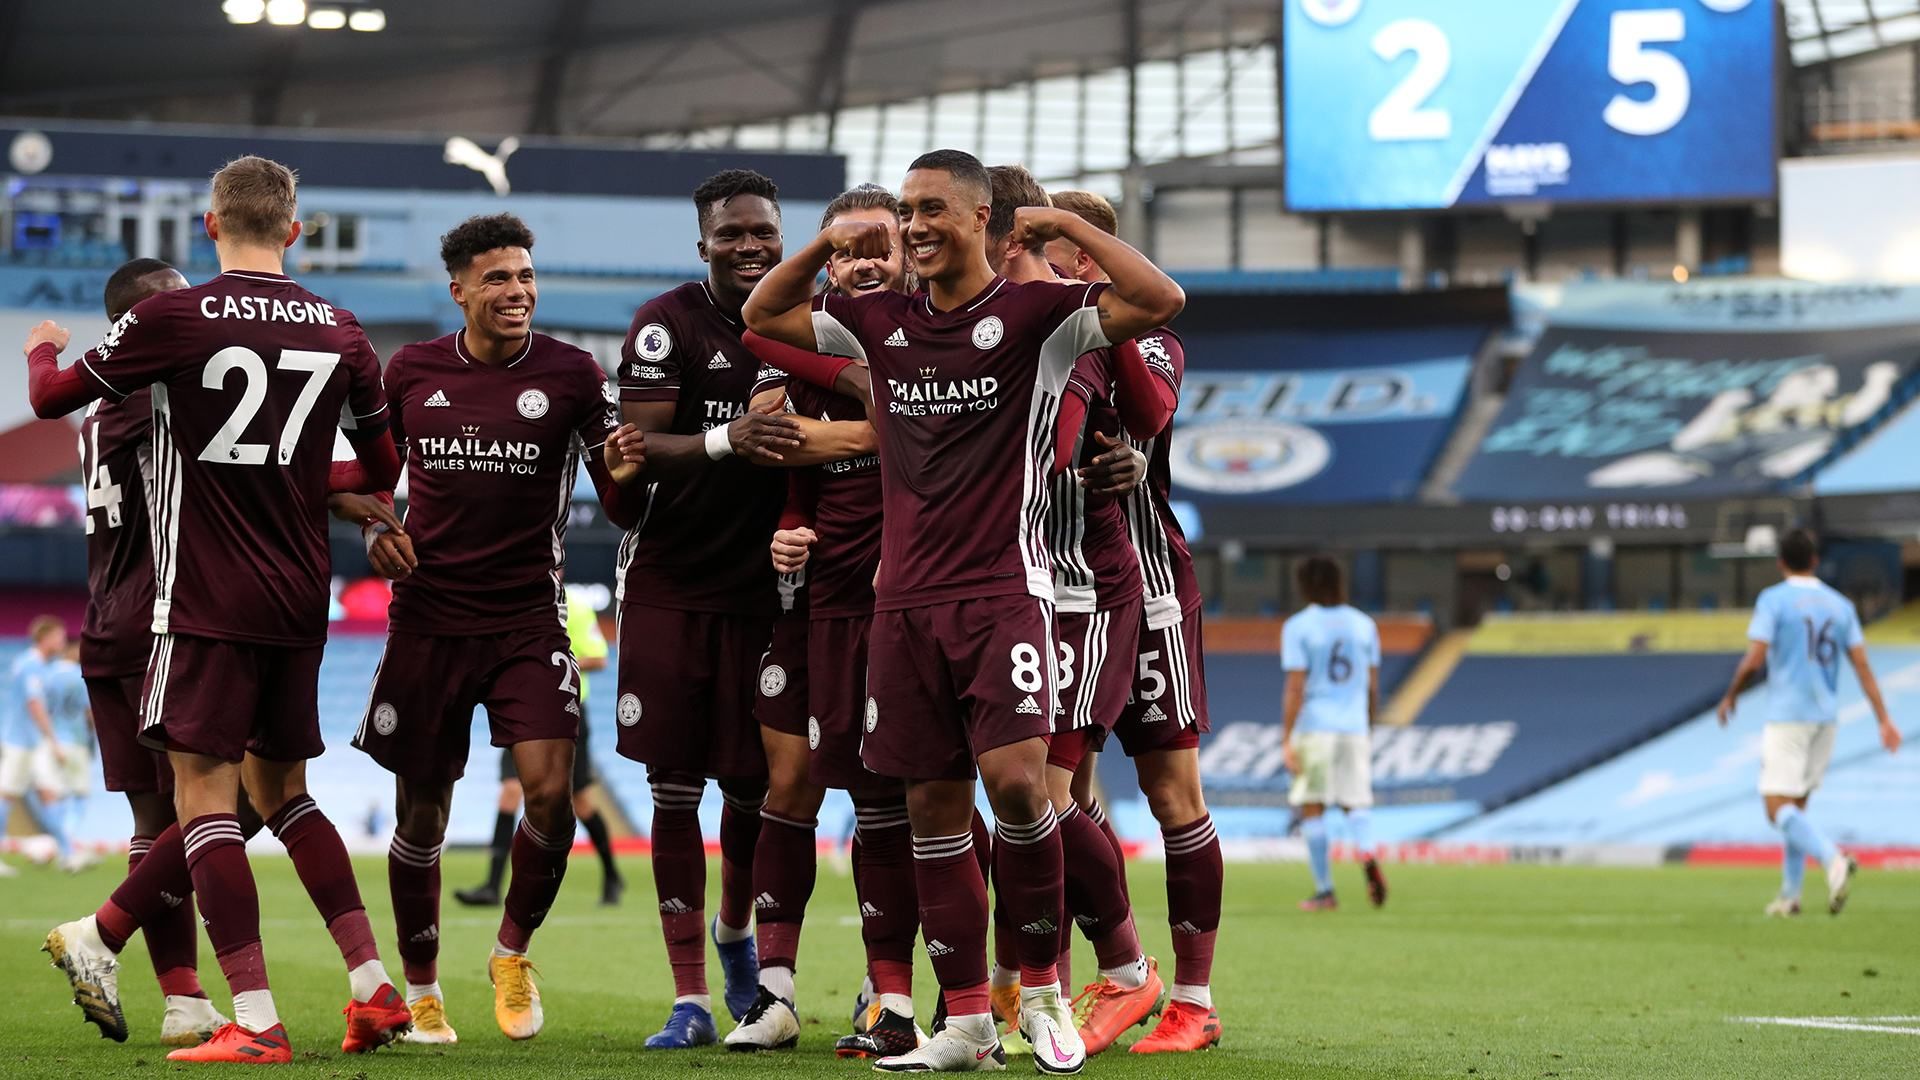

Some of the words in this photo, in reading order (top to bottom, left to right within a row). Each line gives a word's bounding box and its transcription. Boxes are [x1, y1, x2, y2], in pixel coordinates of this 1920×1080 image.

[1369, 18, 1452, 141] 2
[1602, 8, 1691, 136] 5
[200, 296, 337, 326] CASTAGNE
[197, 346, 341, 465] 27
[887, 377, 999, 401] THAILAND
[889, 401, 926, 416] SMILES
[929, 402, 963, 415] WITH
[968, 397, 998, 412] YOU
[418, 438, 541, 460] THAILAND
[423, 459, 465, 471] SMILES
[469, 459, 504, 473] WITH
[509, 463, 538, 475] YOU
[1327, 637, 1353, 684] 6
[1803, 615, 1838, 667] 16
[551, 651, 578, 696] 2
[1011, 642, 1043, 693] 8
[1127, 649, 1167, 705] 5
[1015, 707, 1042, 716] adidas
